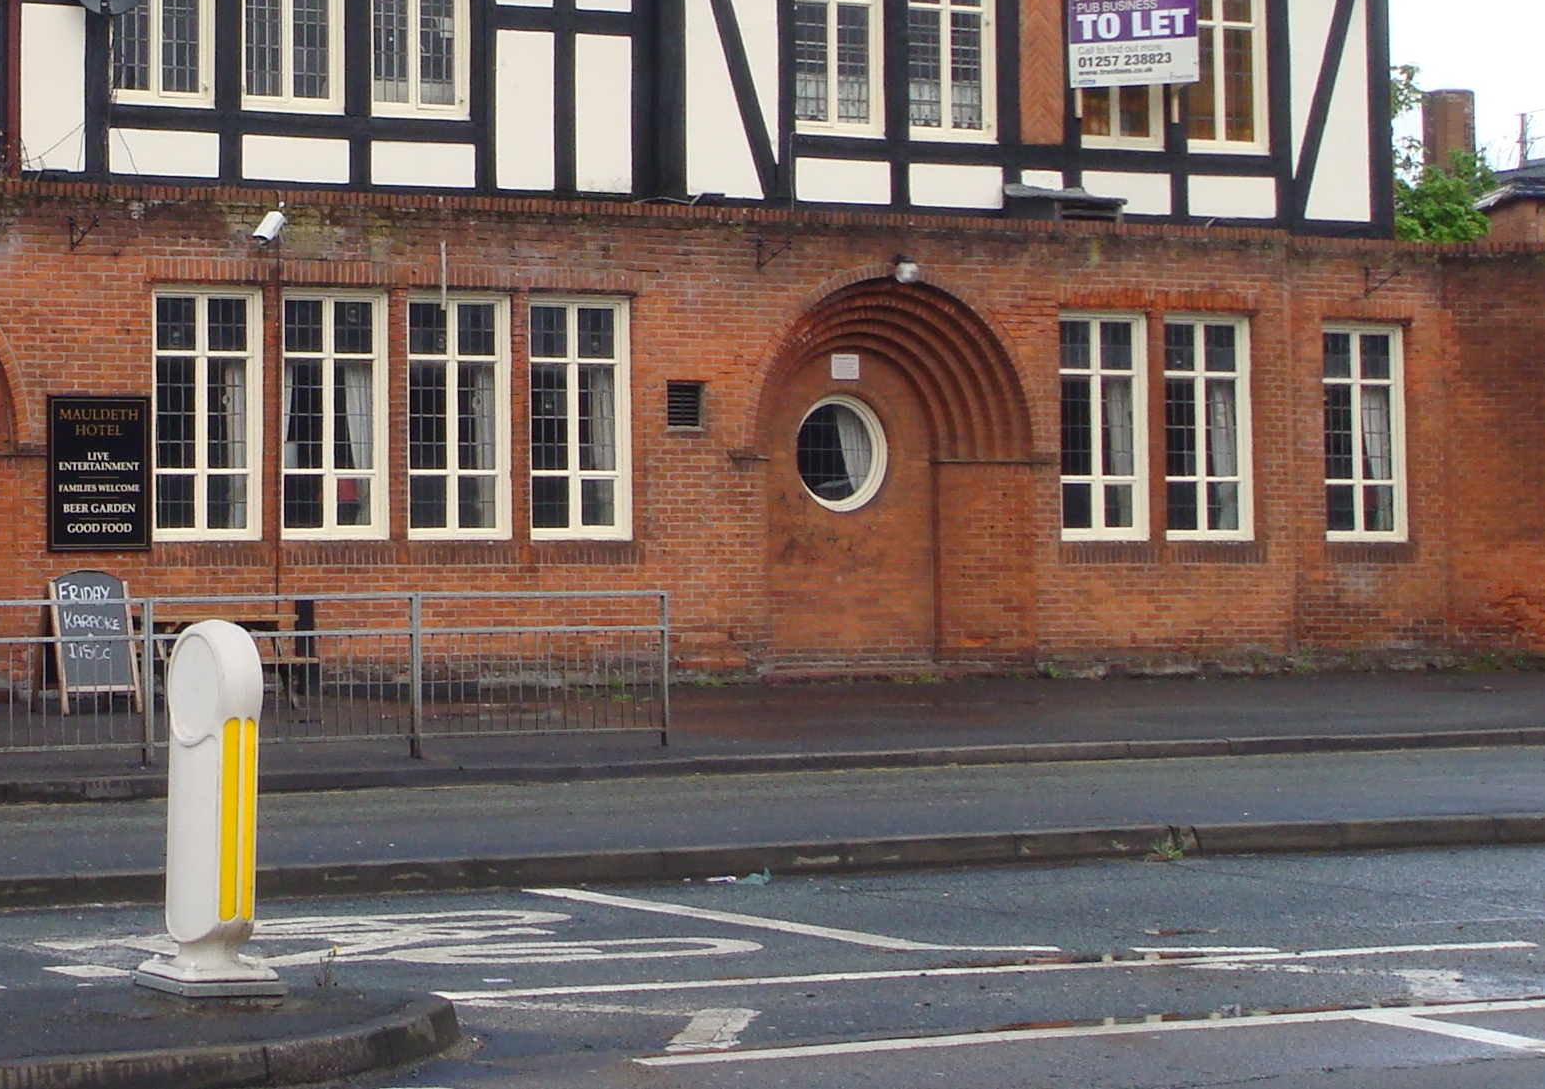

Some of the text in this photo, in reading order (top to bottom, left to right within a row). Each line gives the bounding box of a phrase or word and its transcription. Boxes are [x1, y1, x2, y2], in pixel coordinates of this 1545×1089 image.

[1077, 0, 1158, 13] PUB BUSINESS
[1076, 8, 1190, 40] TO LET
[1077, 45, 1095, 56] Call
[1096, 44, 1105, 54] to
[1106, 43, 1123, 54] find
[1125, 43, 1139, 53] out
[1078, 52, 1172, 68] 01257 238823
[59, 408, 139, 420] MAULDETH
[75, 424, 123, 436] HOTEL
[87, 452, 110, 461] LIVE
[58, 461, 140, 471] ENTERTAINMENT
[58, 484, 140, 492] FAMILIES WELCOME
[63, 503, 136, 513] BEER GARDEN
[67, 523, 133, 533] GOOD FOOD
[58, 582, 111, 600] FRIDAY
[63, 610, 121, 630] KARAOKE
